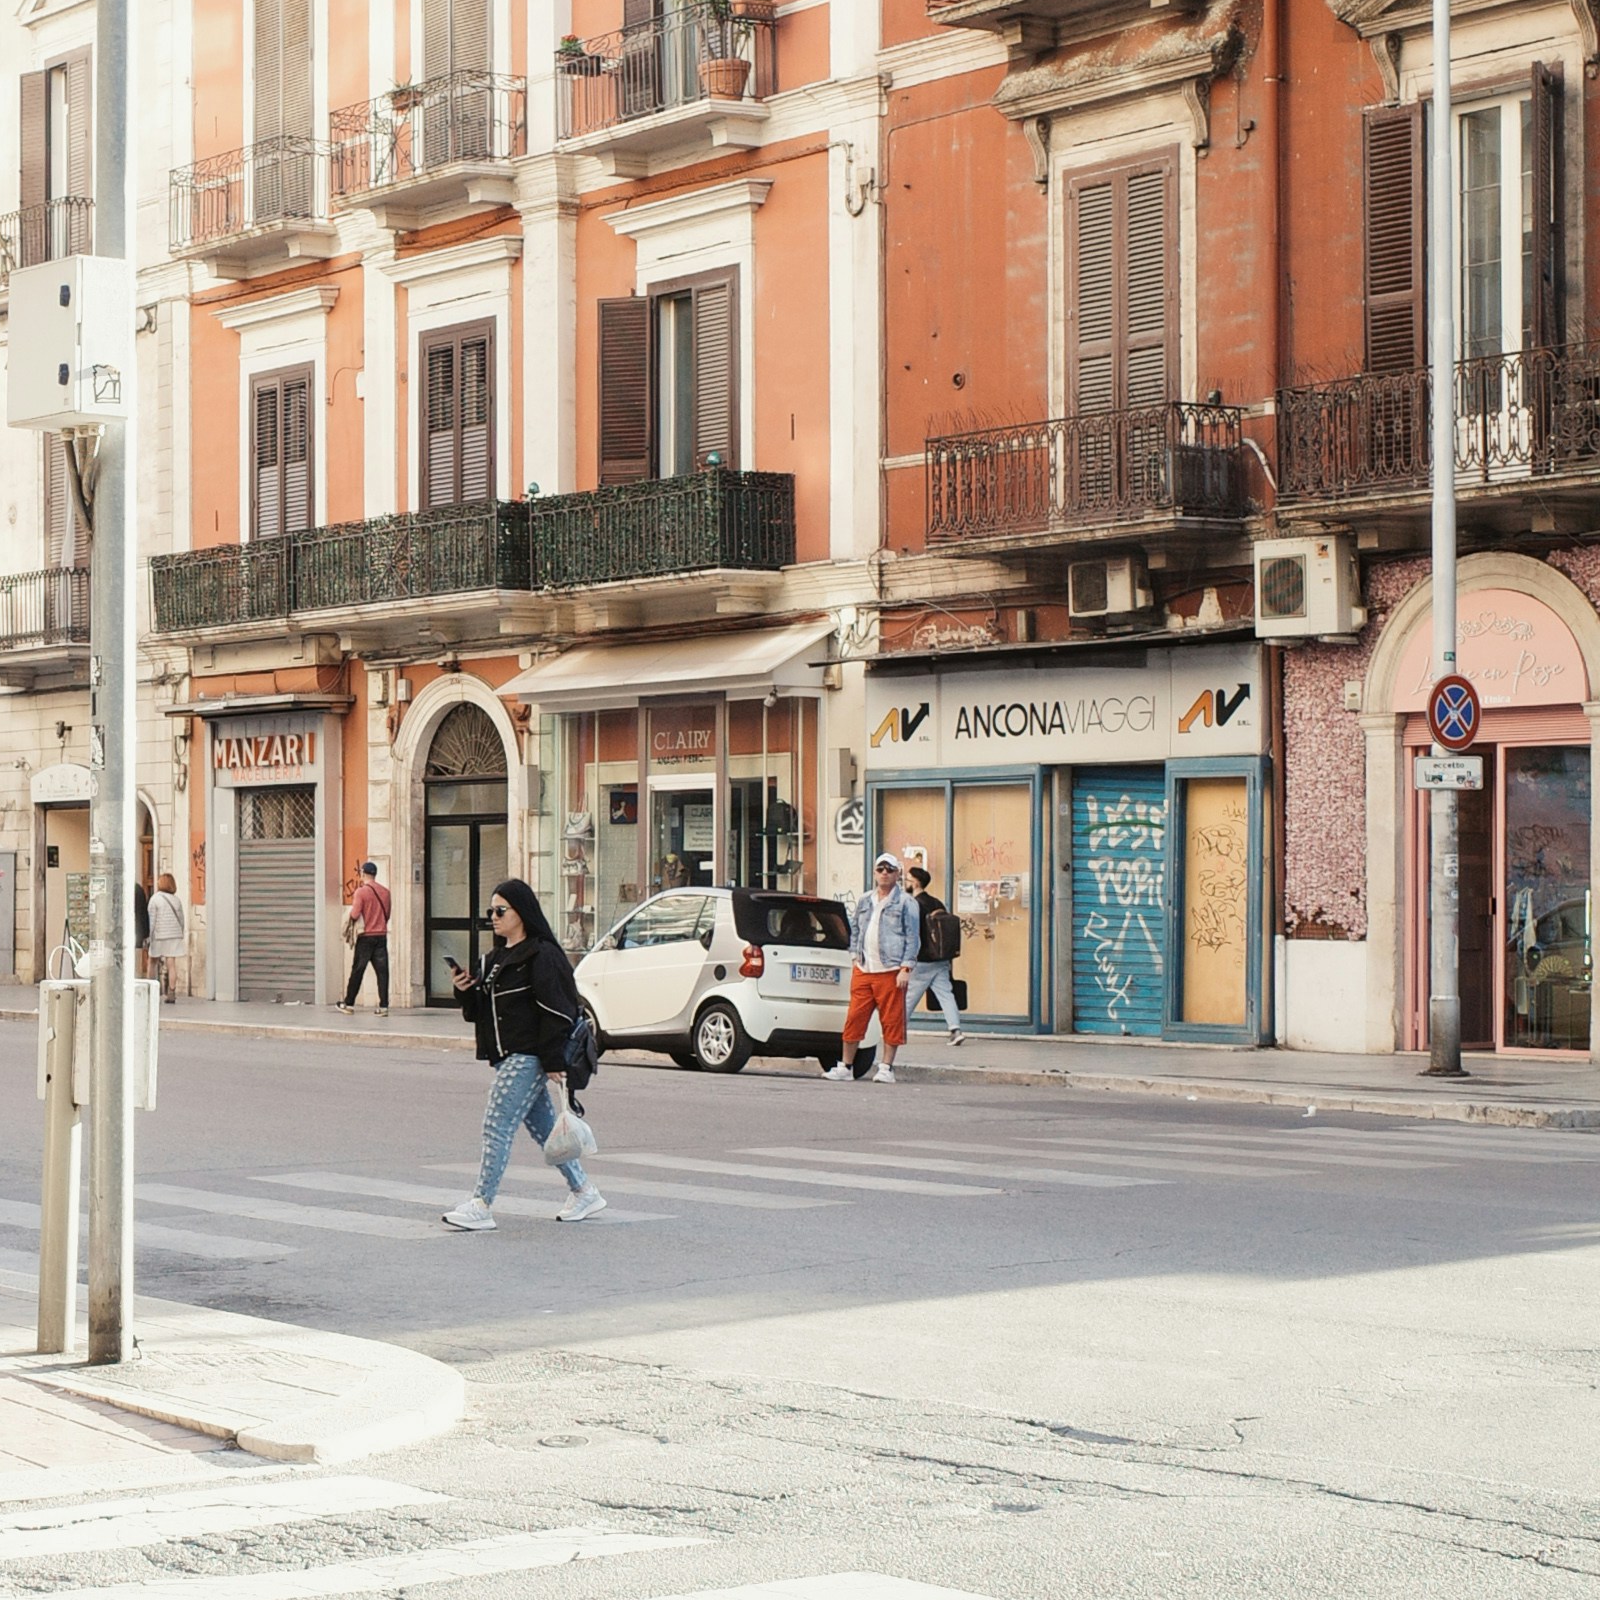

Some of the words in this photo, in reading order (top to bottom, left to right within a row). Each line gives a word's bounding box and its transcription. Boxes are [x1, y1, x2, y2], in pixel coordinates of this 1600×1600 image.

[214, 732, 315, 769] MANZARI
[654, 730, 712, 751] CLAIRY
[231, 766, 303, 782] MACELLERIA
